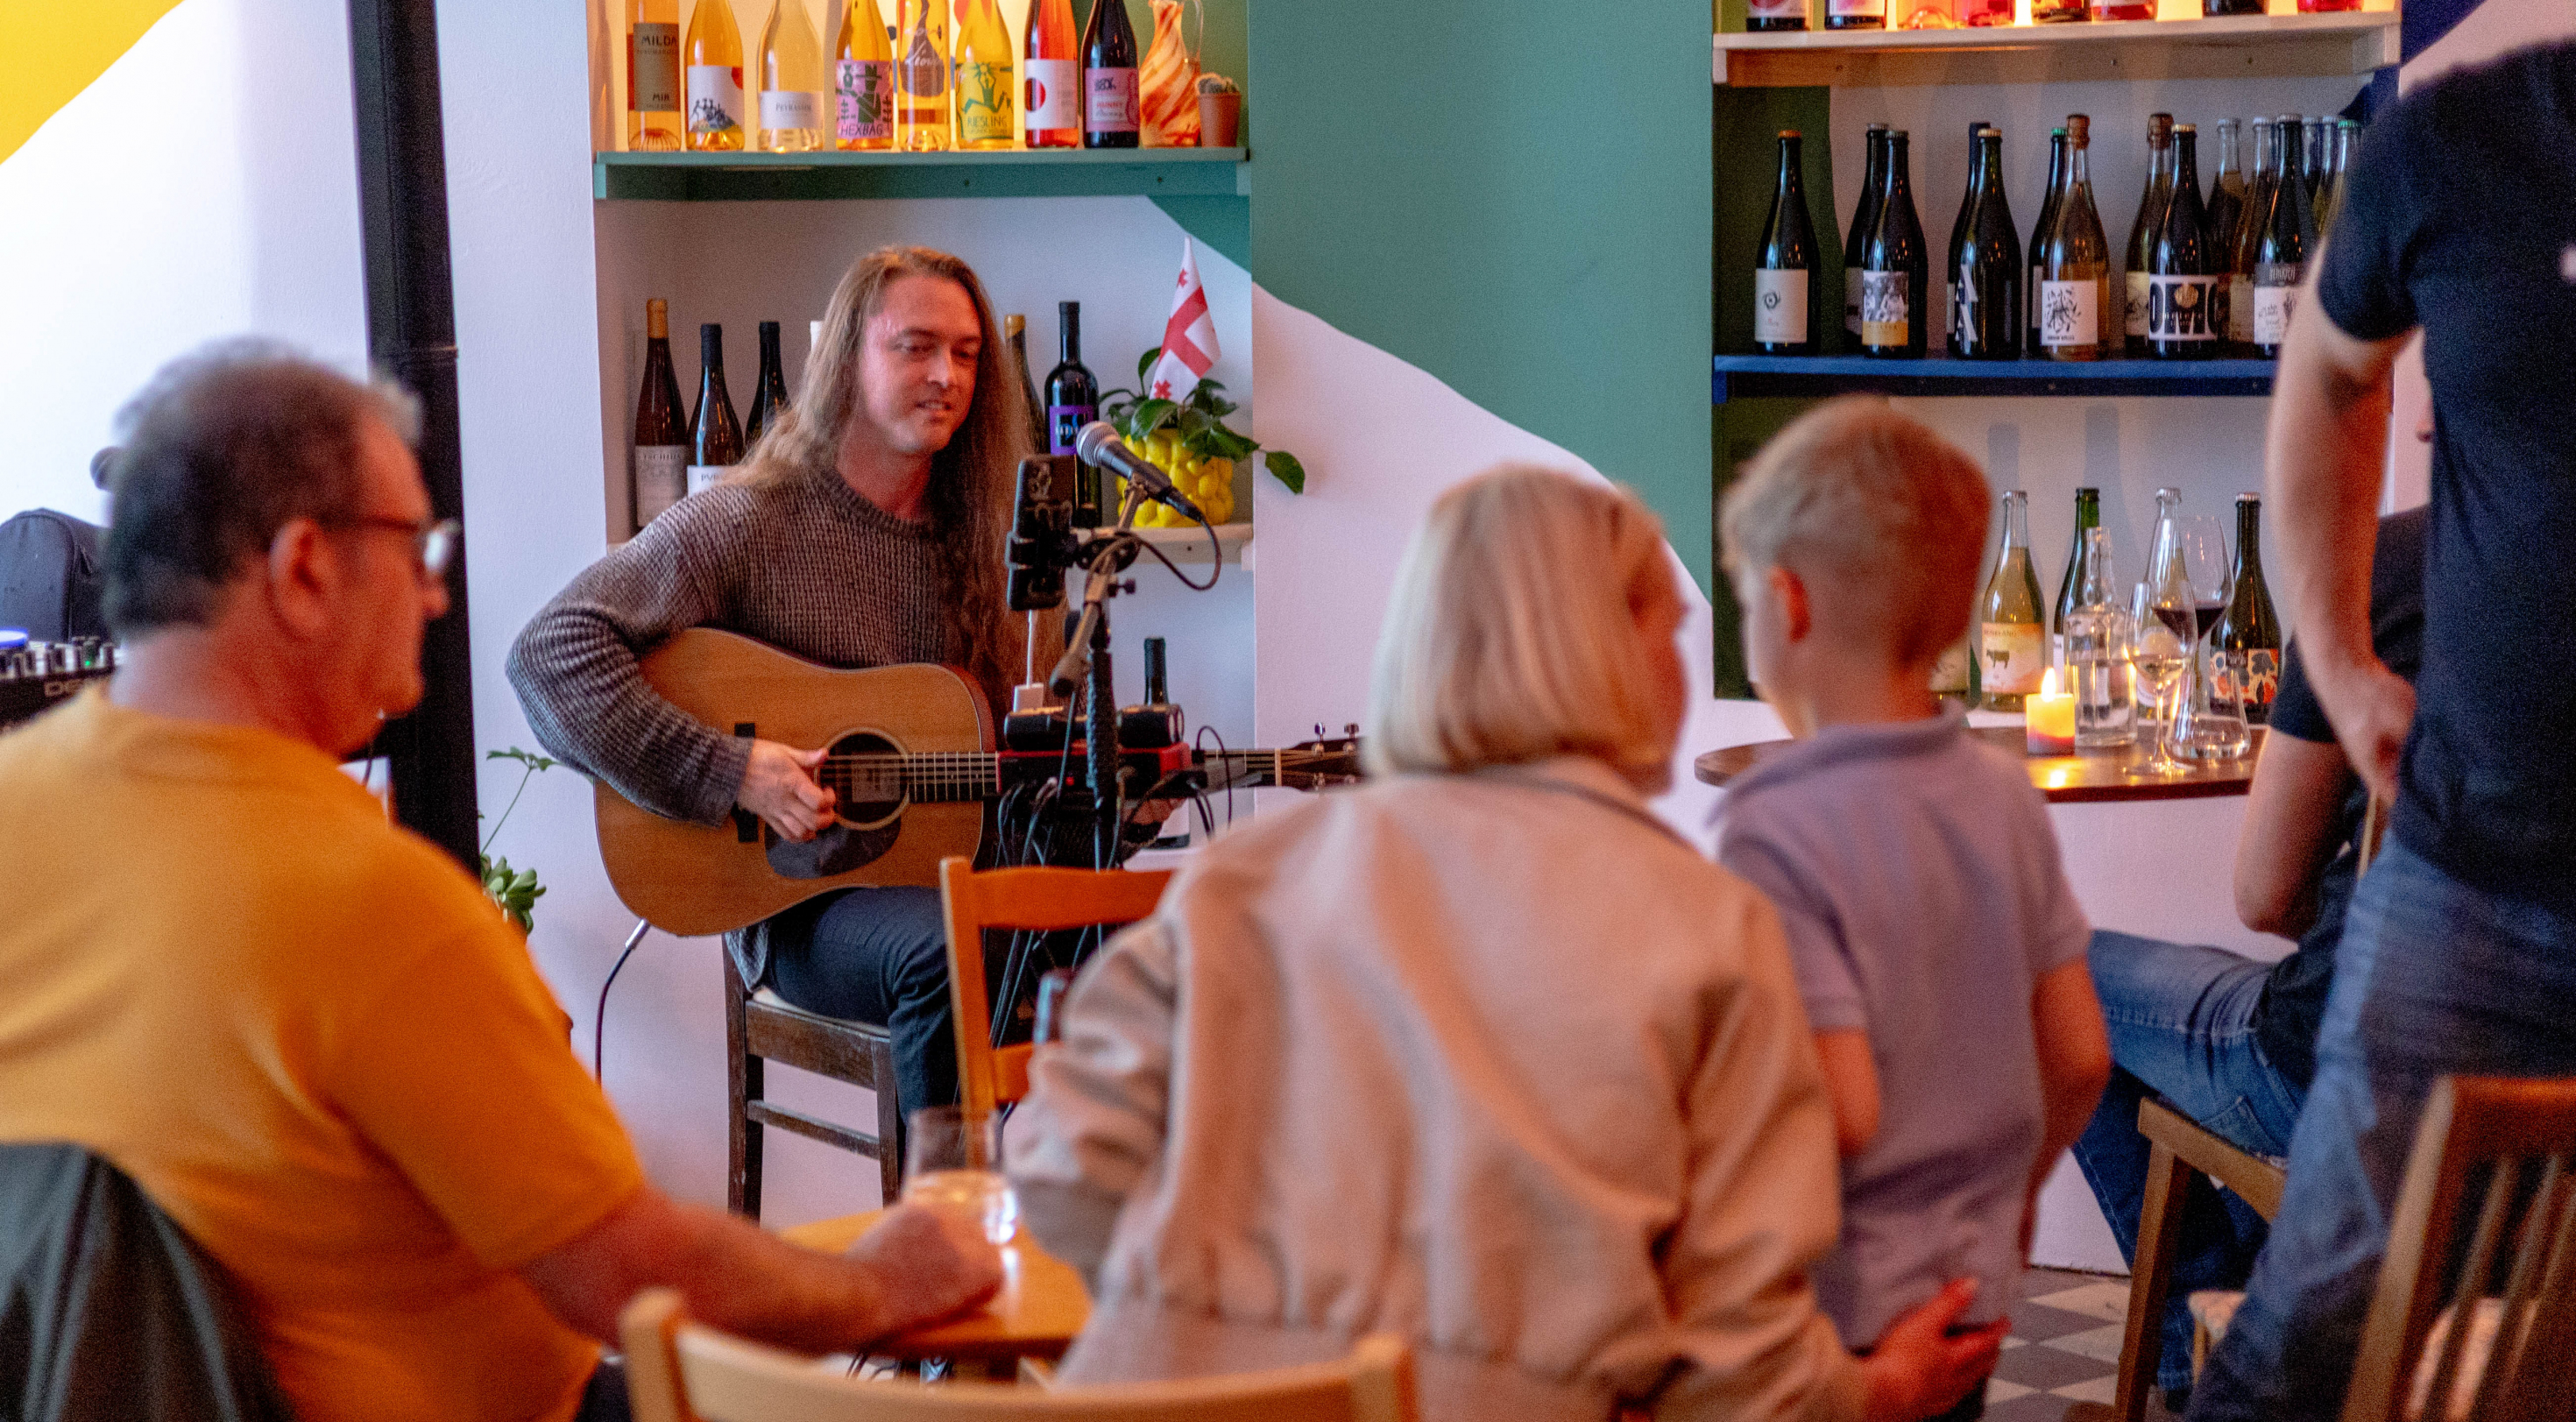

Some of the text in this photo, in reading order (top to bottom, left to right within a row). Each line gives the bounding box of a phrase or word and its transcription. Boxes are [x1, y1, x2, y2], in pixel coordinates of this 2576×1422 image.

[641, 35, 677, 46] MILDA
[967, 116, 1008, 126] RIESLING
[840, 124, 883, 137] HEXBAG
